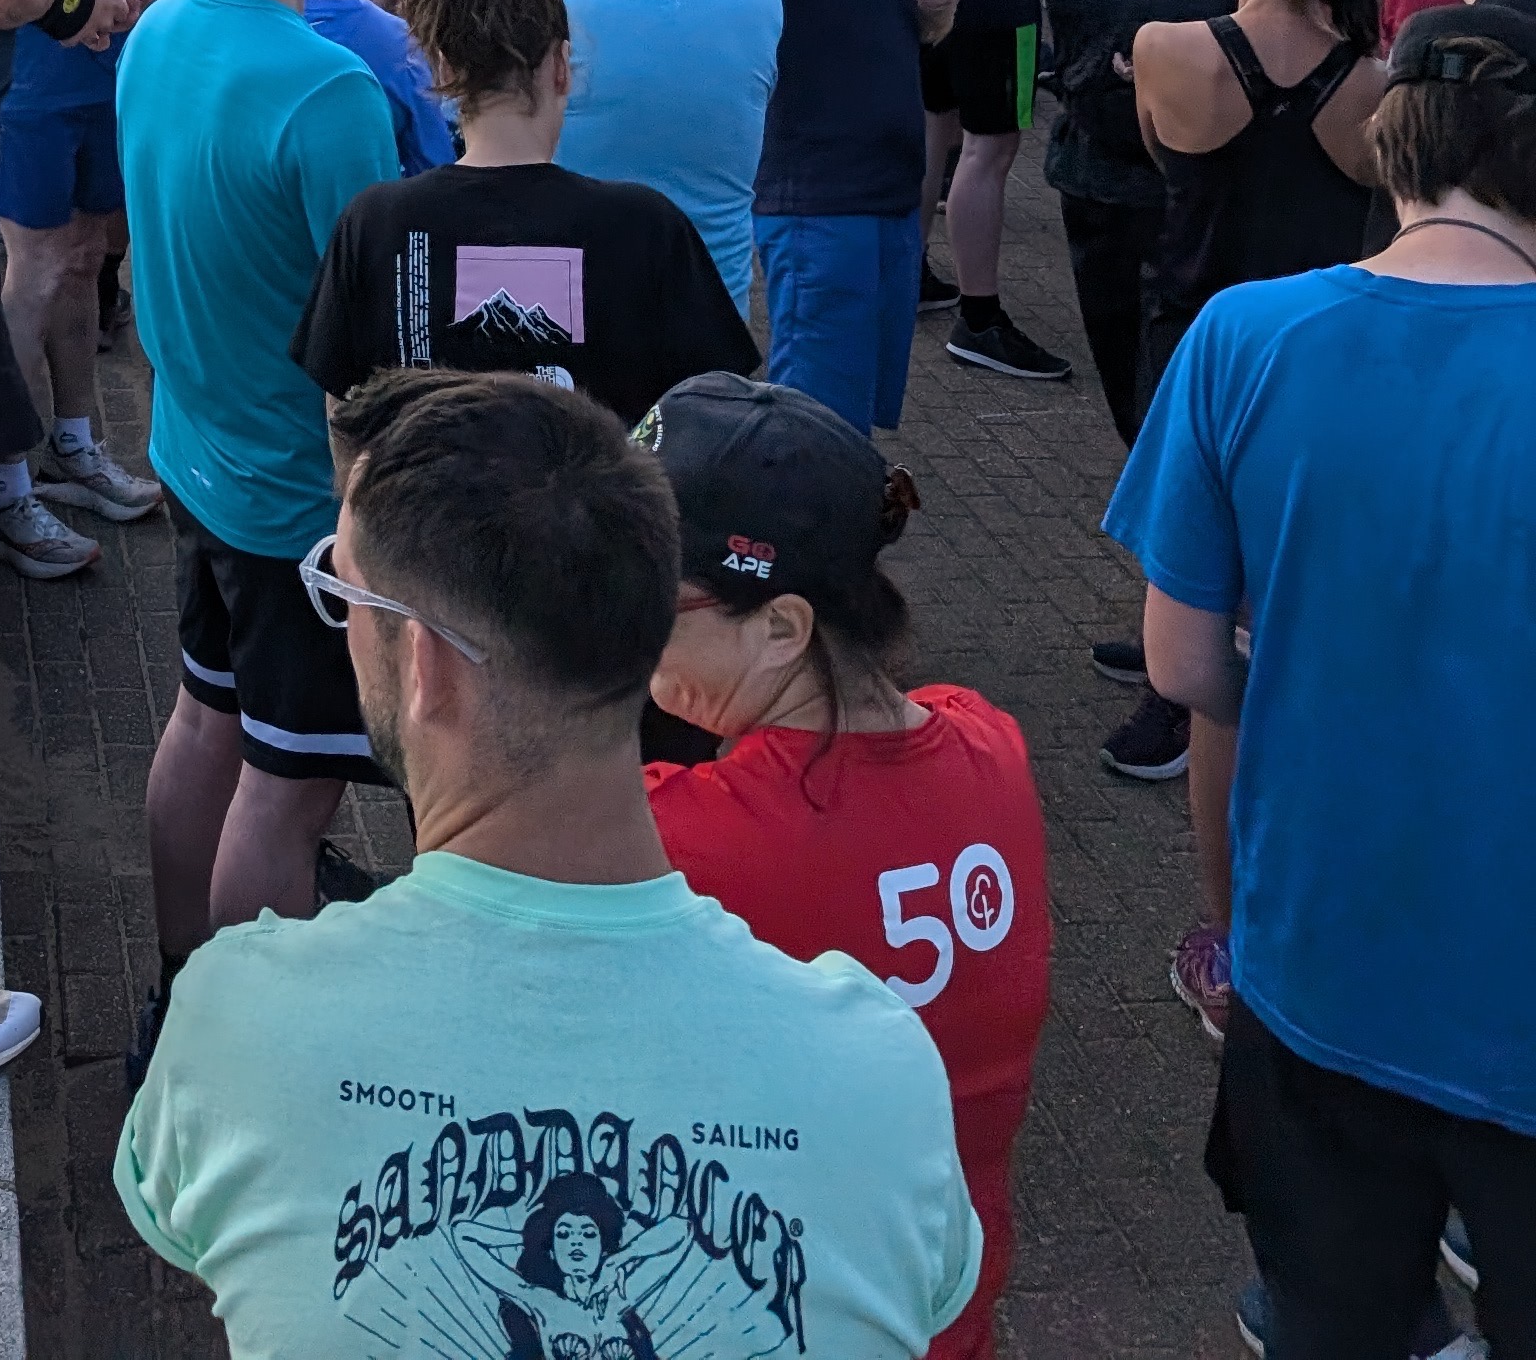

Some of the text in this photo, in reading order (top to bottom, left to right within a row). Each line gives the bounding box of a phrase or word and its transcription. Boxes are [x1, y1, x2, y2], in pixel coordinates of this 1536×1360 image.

[536, 365, 556, 375] THE
[721, 552, 774, 579] APE
[877, 843, 1015, 1008] 50
[340, 1081, 456, 1117] SMOOTH
[691, 1122, 800, 1151] SAILING
